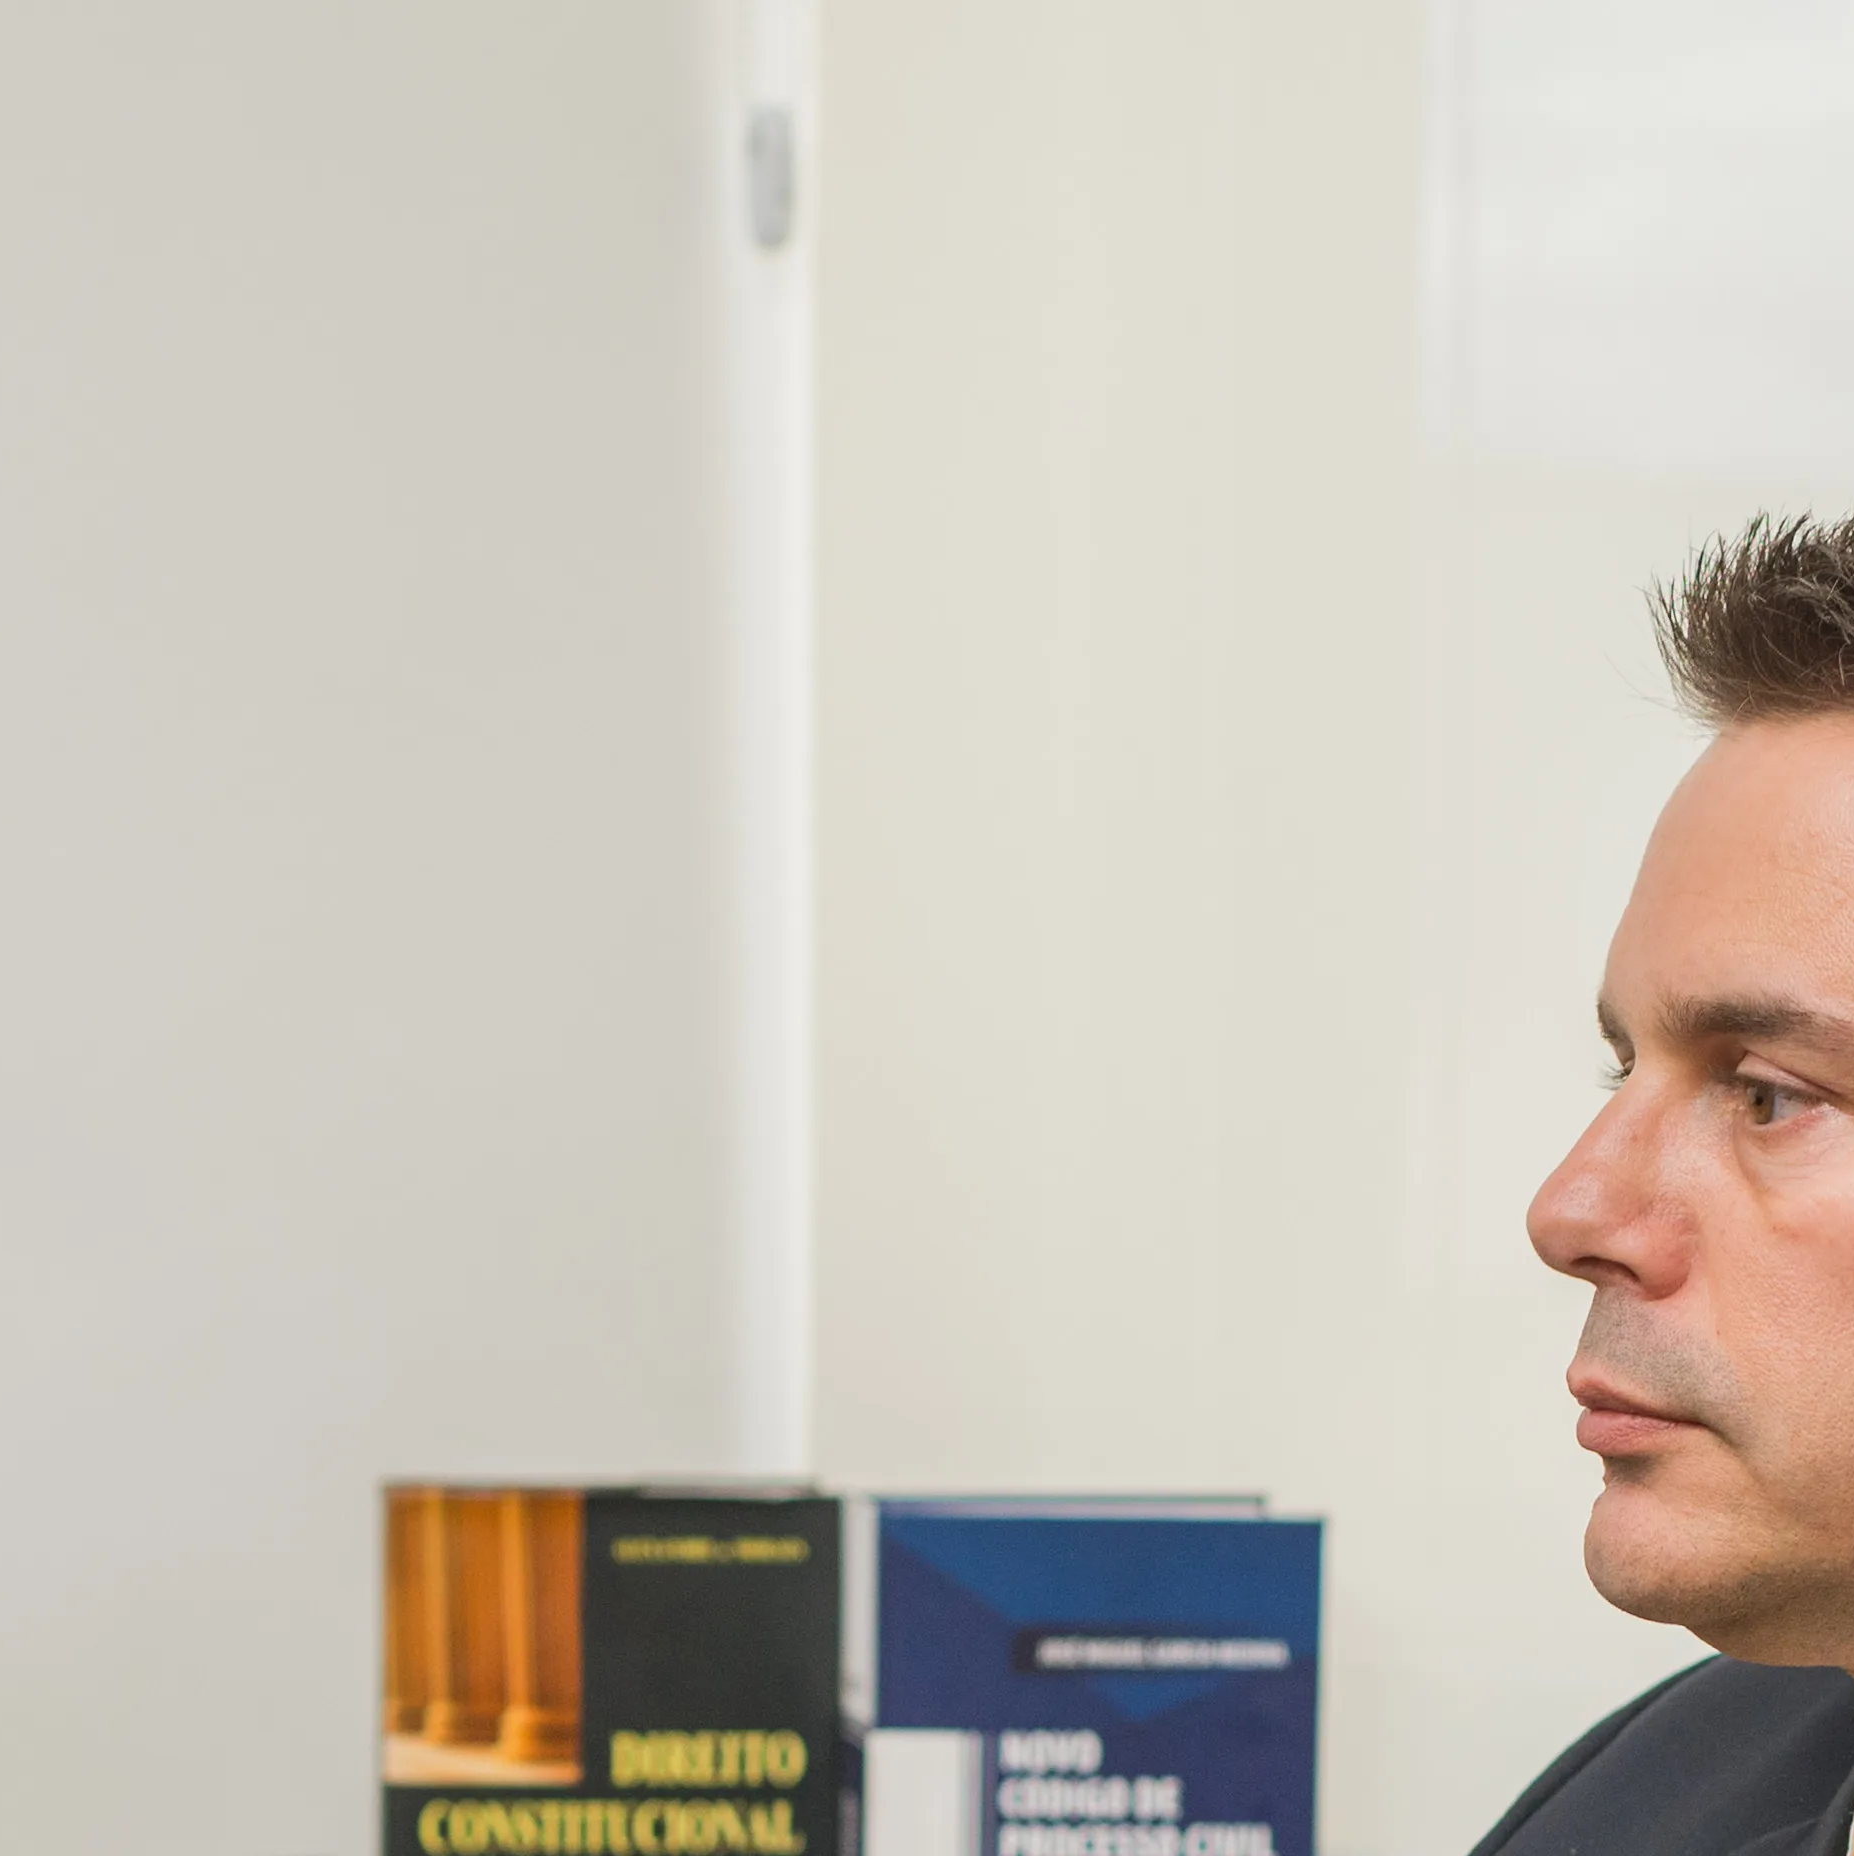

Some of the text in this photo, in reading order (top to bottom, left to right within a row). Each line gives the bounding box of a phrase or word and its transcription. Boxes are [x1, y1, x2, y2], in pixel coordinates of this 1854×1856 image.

[612, 1732, 806, 1786] DIREITO
[999, 1730, 1103, 1773] NOVO
[1133, 1775, 1183, 1820] DE
[420, 1800, 805, 1856] CONSTITUCIONAL
